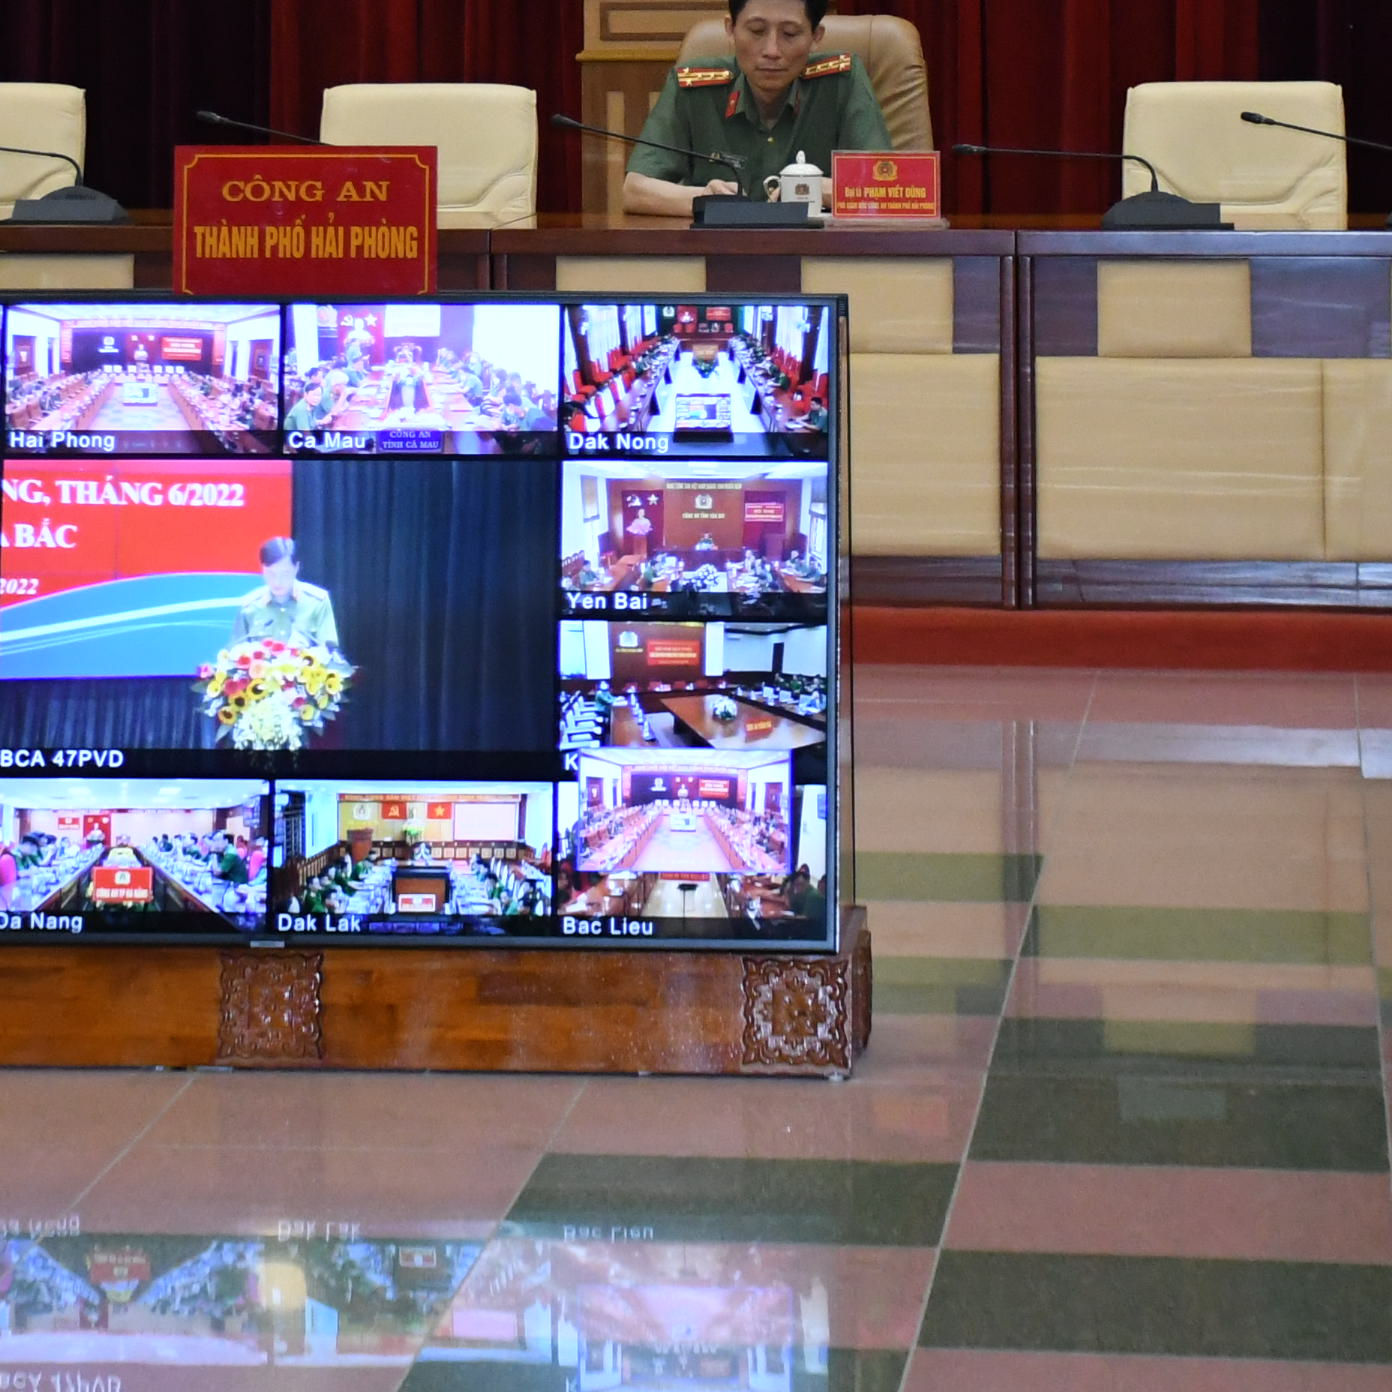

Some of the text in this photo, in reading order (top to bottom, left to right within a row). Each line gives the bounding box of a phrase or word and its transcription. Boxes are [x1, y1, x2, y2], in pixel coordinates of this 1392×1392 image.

[221, 174, 391, 202] CÔNG AN
[193, 212, 419, 259] THÀNH PHỐ HẢI PHÒNG
[9, 431, 116, 453] Hai Phong
[288, 431, 366, 449] Ca Mau
[568, 432, 670, 454] Dak Nong
[54, 475, 164, 506] THÁNG
[168, 482, 245, 507] 6/2022
[566, 592, 648, 610] Yen Bai
[0, 749, 125, 768] BCA 47PVD
[27, 912, 84, 934] Nang
[277, 914, 361, 932] Dak Lak
[562, 918, 653, 936] Bac Lieu
